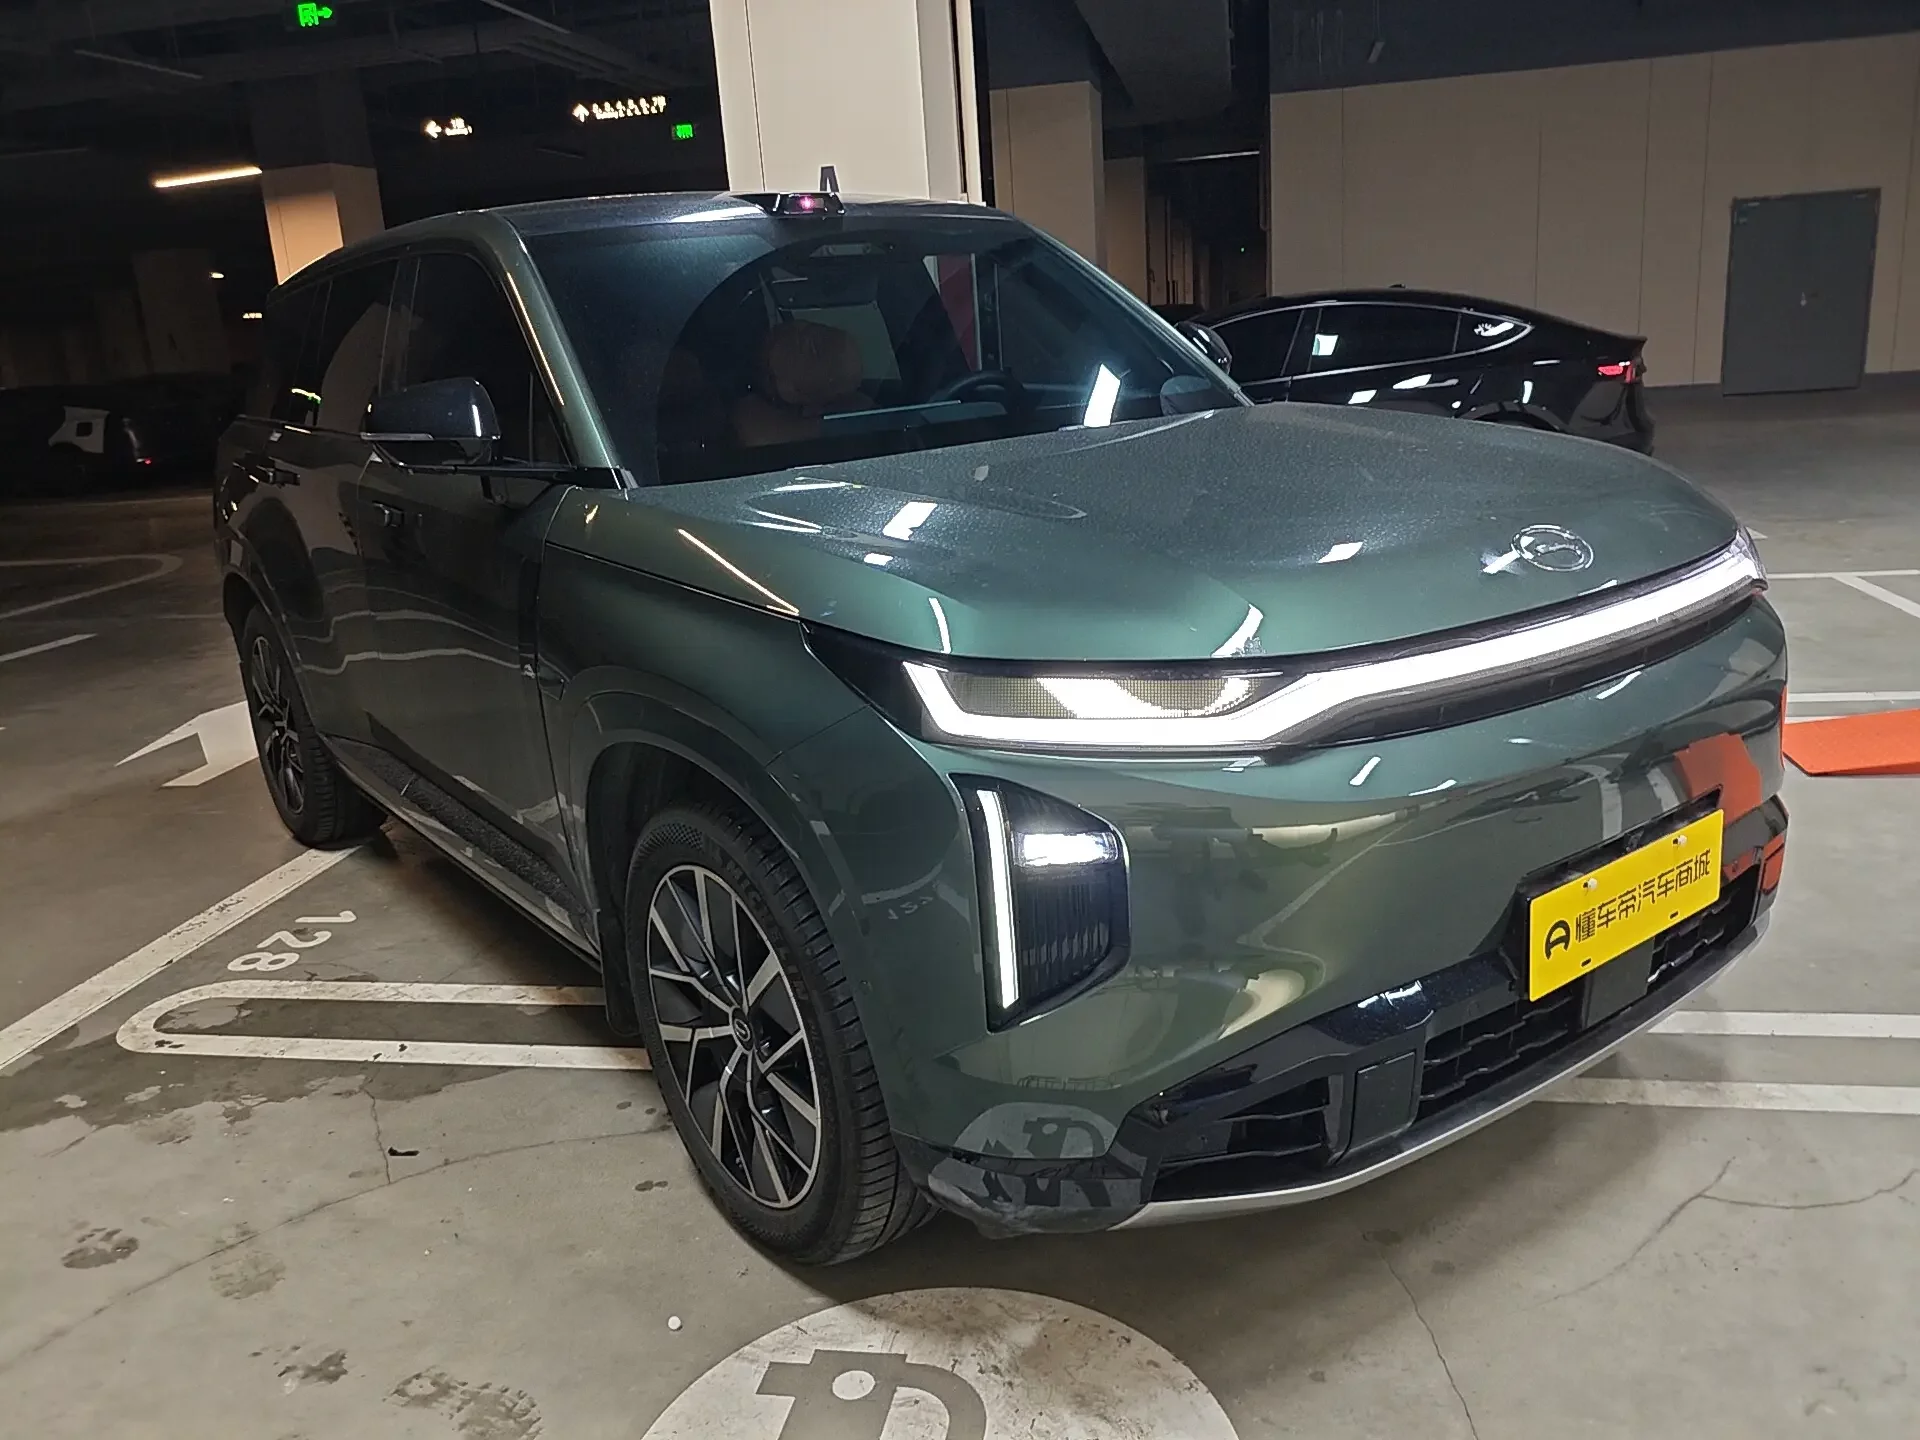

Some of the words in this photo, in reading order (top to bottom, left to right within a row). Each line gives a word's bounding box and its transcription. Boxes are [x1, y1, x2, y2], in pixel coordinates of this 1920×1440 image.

[1575, 849, 1711, 942] 懂车帝汽车商城
[227, 910, 357, 972] 128
